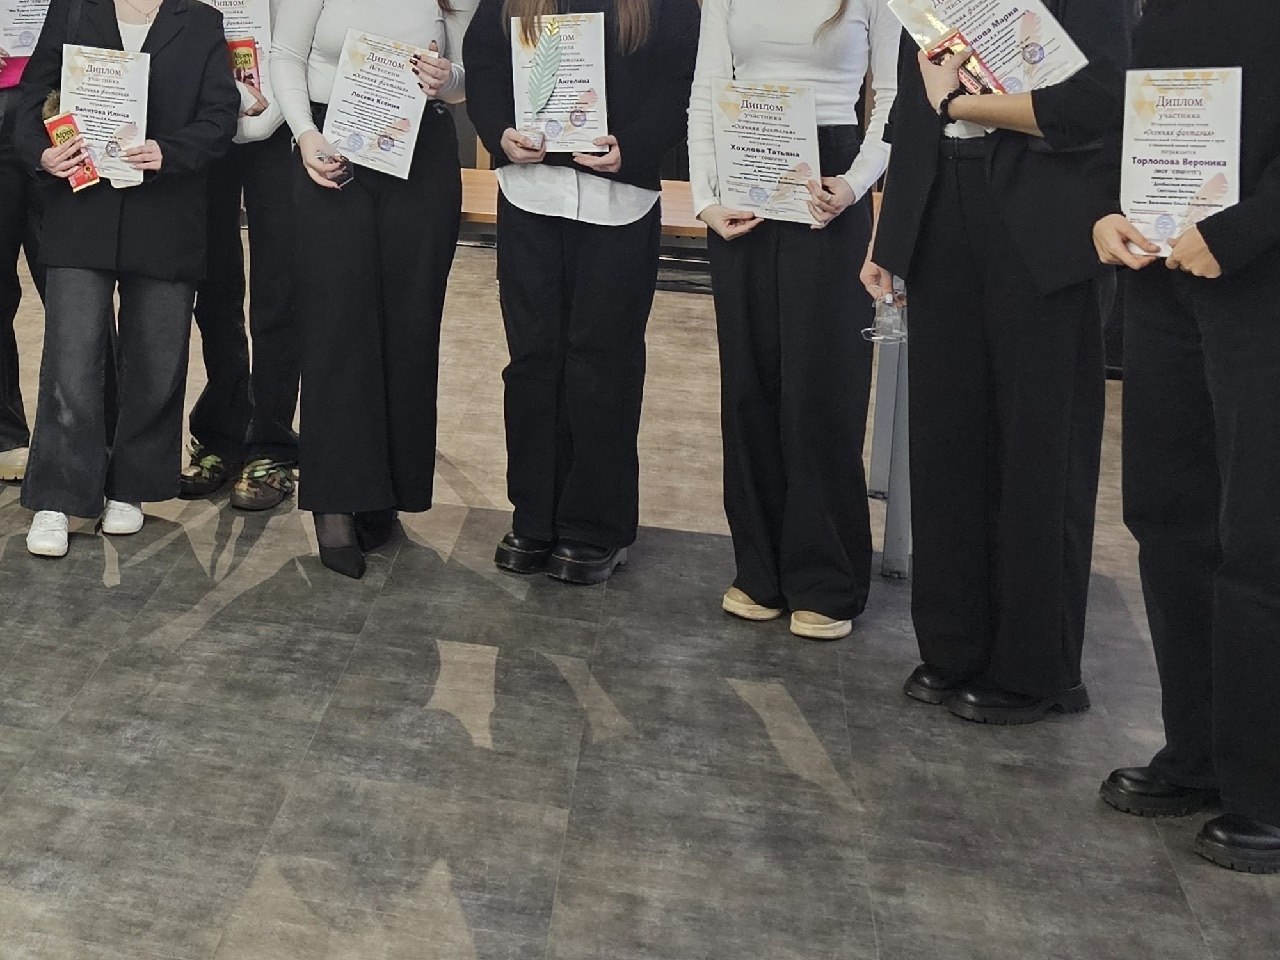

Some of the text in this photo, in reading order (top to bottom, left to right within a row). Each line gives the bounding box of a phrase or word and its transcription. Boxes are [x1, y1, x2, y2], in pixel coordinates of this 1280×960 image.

[991, 7, 1019, 28] Мария
[85, 64, 122, 76] Диплом
[740, 99, 784, 112] Диплом
[1156, 95, 1204, 109] Диплом
[1158, 113, 1201, 121] участника
[730, 143, 801, 158] Хохлова Татьяна
[1132, 156, 1227, 168] Торлопова Вероника
